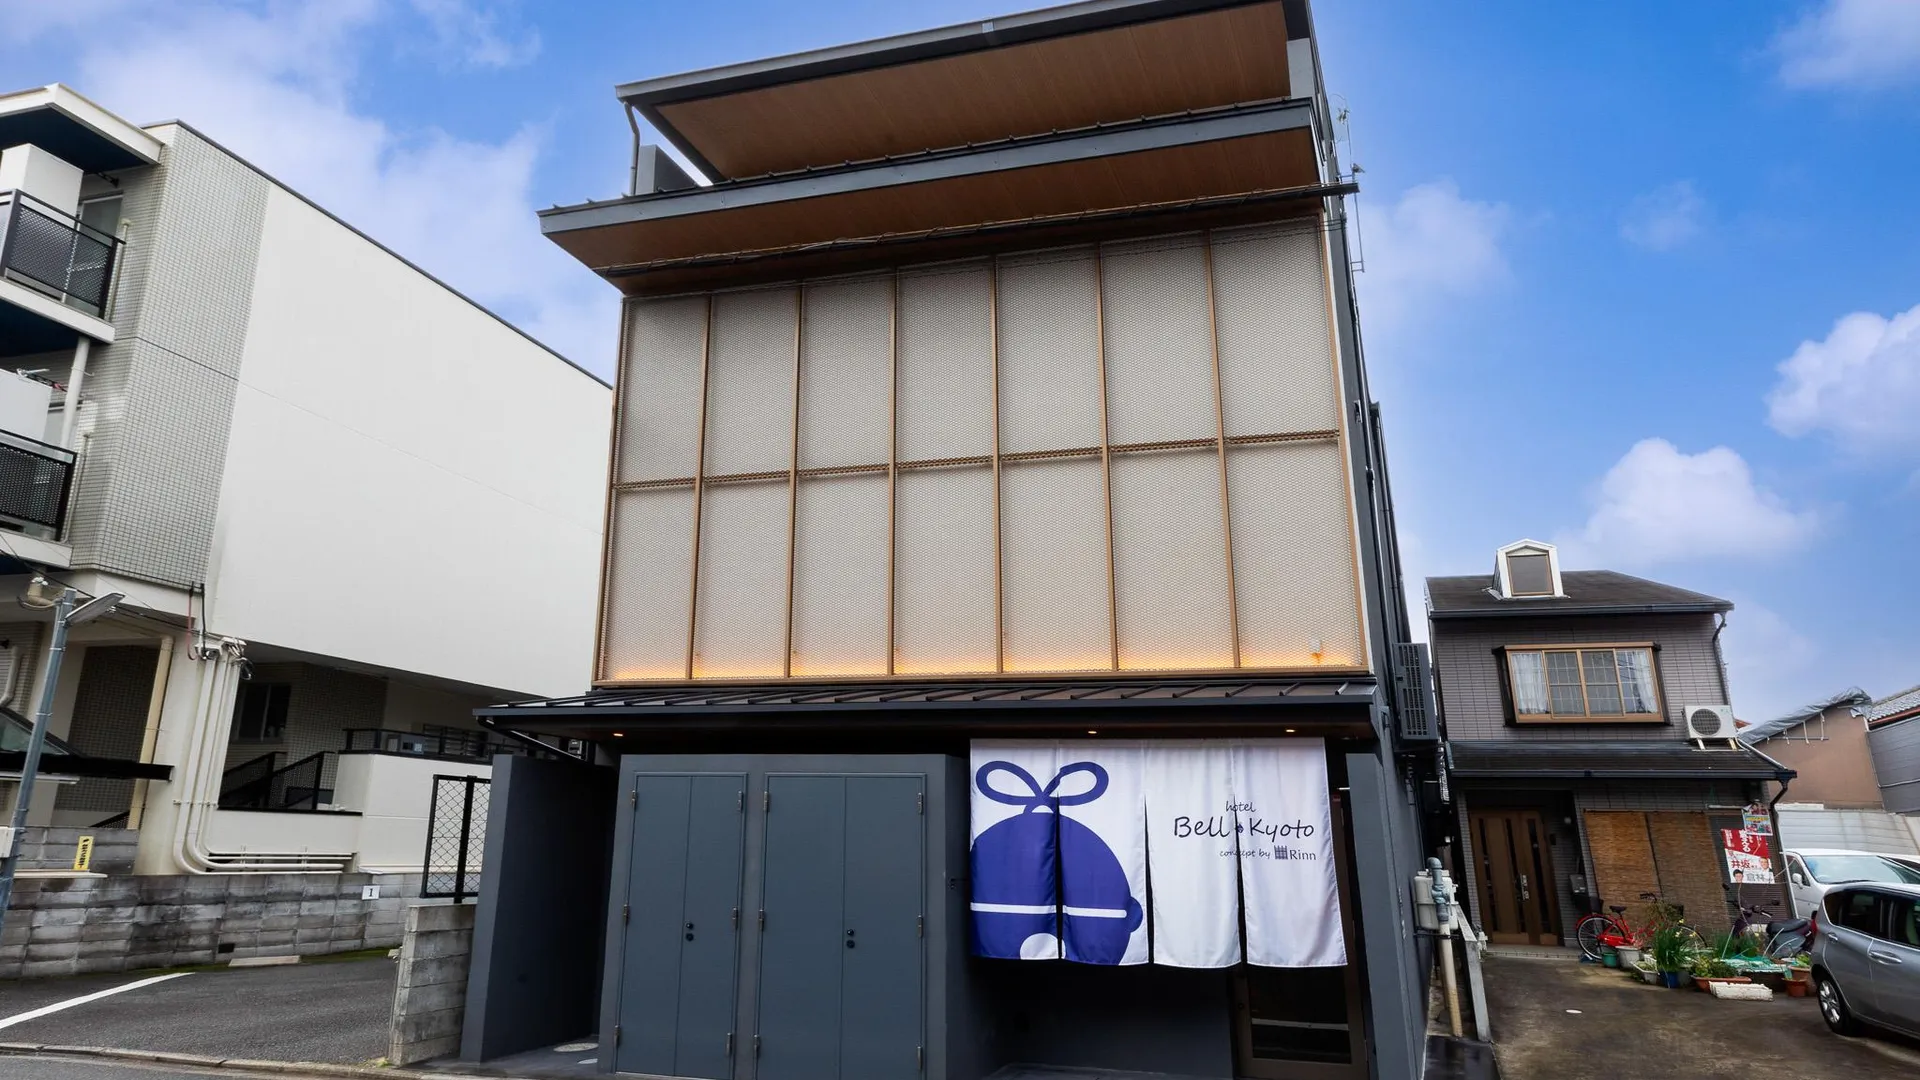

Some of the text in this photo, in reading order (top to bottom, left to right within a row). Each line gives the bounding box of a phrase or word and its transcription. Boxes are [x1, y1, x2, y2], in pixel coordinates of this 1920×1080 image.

[1225, 801, 1256, 812] hotel
[1174, 816, 1314, 842] Bell Kyoto
[1220, 848, 1317, 861] conept by Rinn
[369, 888, 373, 897] 1
